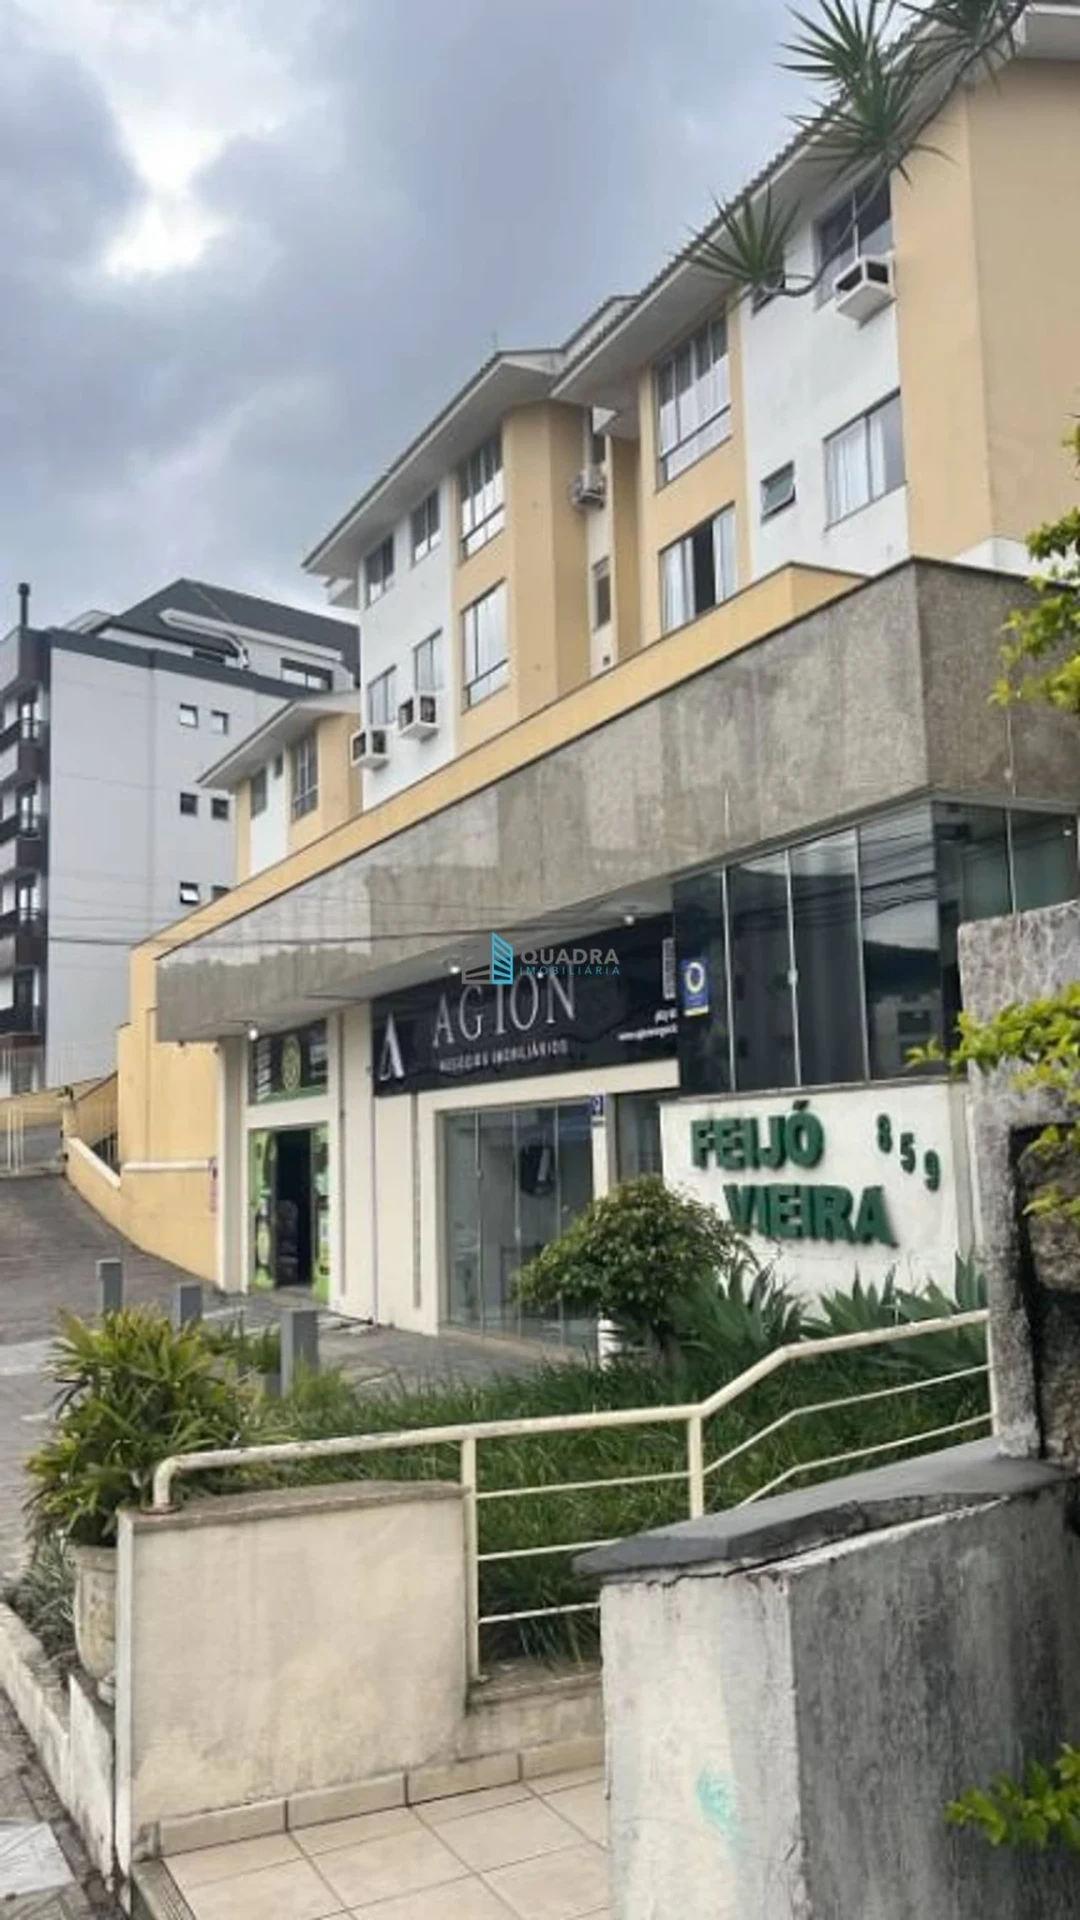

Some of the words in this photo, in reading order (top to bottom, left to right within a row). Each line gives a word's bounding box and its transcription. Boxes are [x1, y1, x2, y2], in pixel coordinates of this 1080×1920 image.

[690, 1100, 825, 1171] FEIJÓ
[876, 1113, 941, 1192] 859
[722, 1183, 899, 1248] VIEIRA
